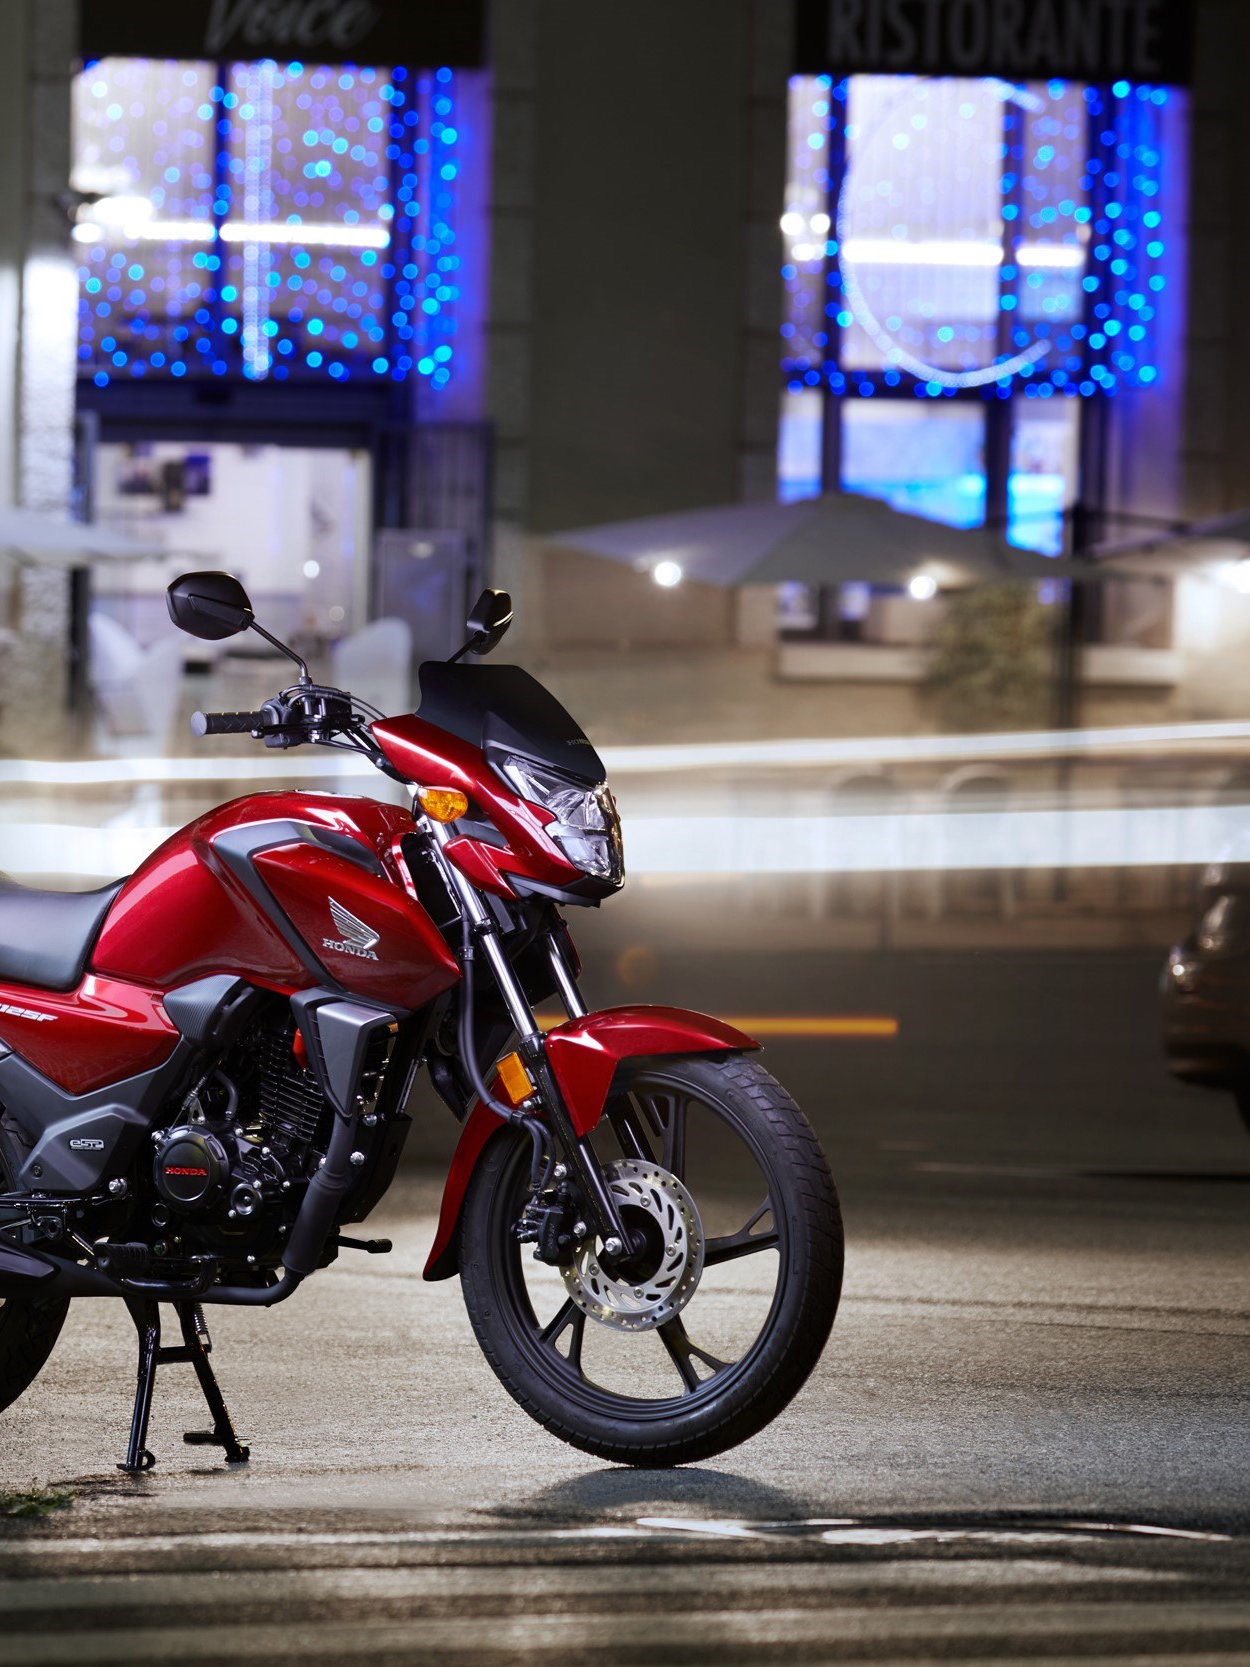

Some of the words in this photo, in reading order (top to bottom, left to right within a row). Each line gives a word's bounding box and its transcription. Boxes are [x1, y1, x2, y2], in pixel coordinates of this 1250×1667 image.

[828, 0, 1162, 70] RISTORANTE
[322, 938, 380, 961] HONDA
[165, 1167, 207, 1176] HONDA
